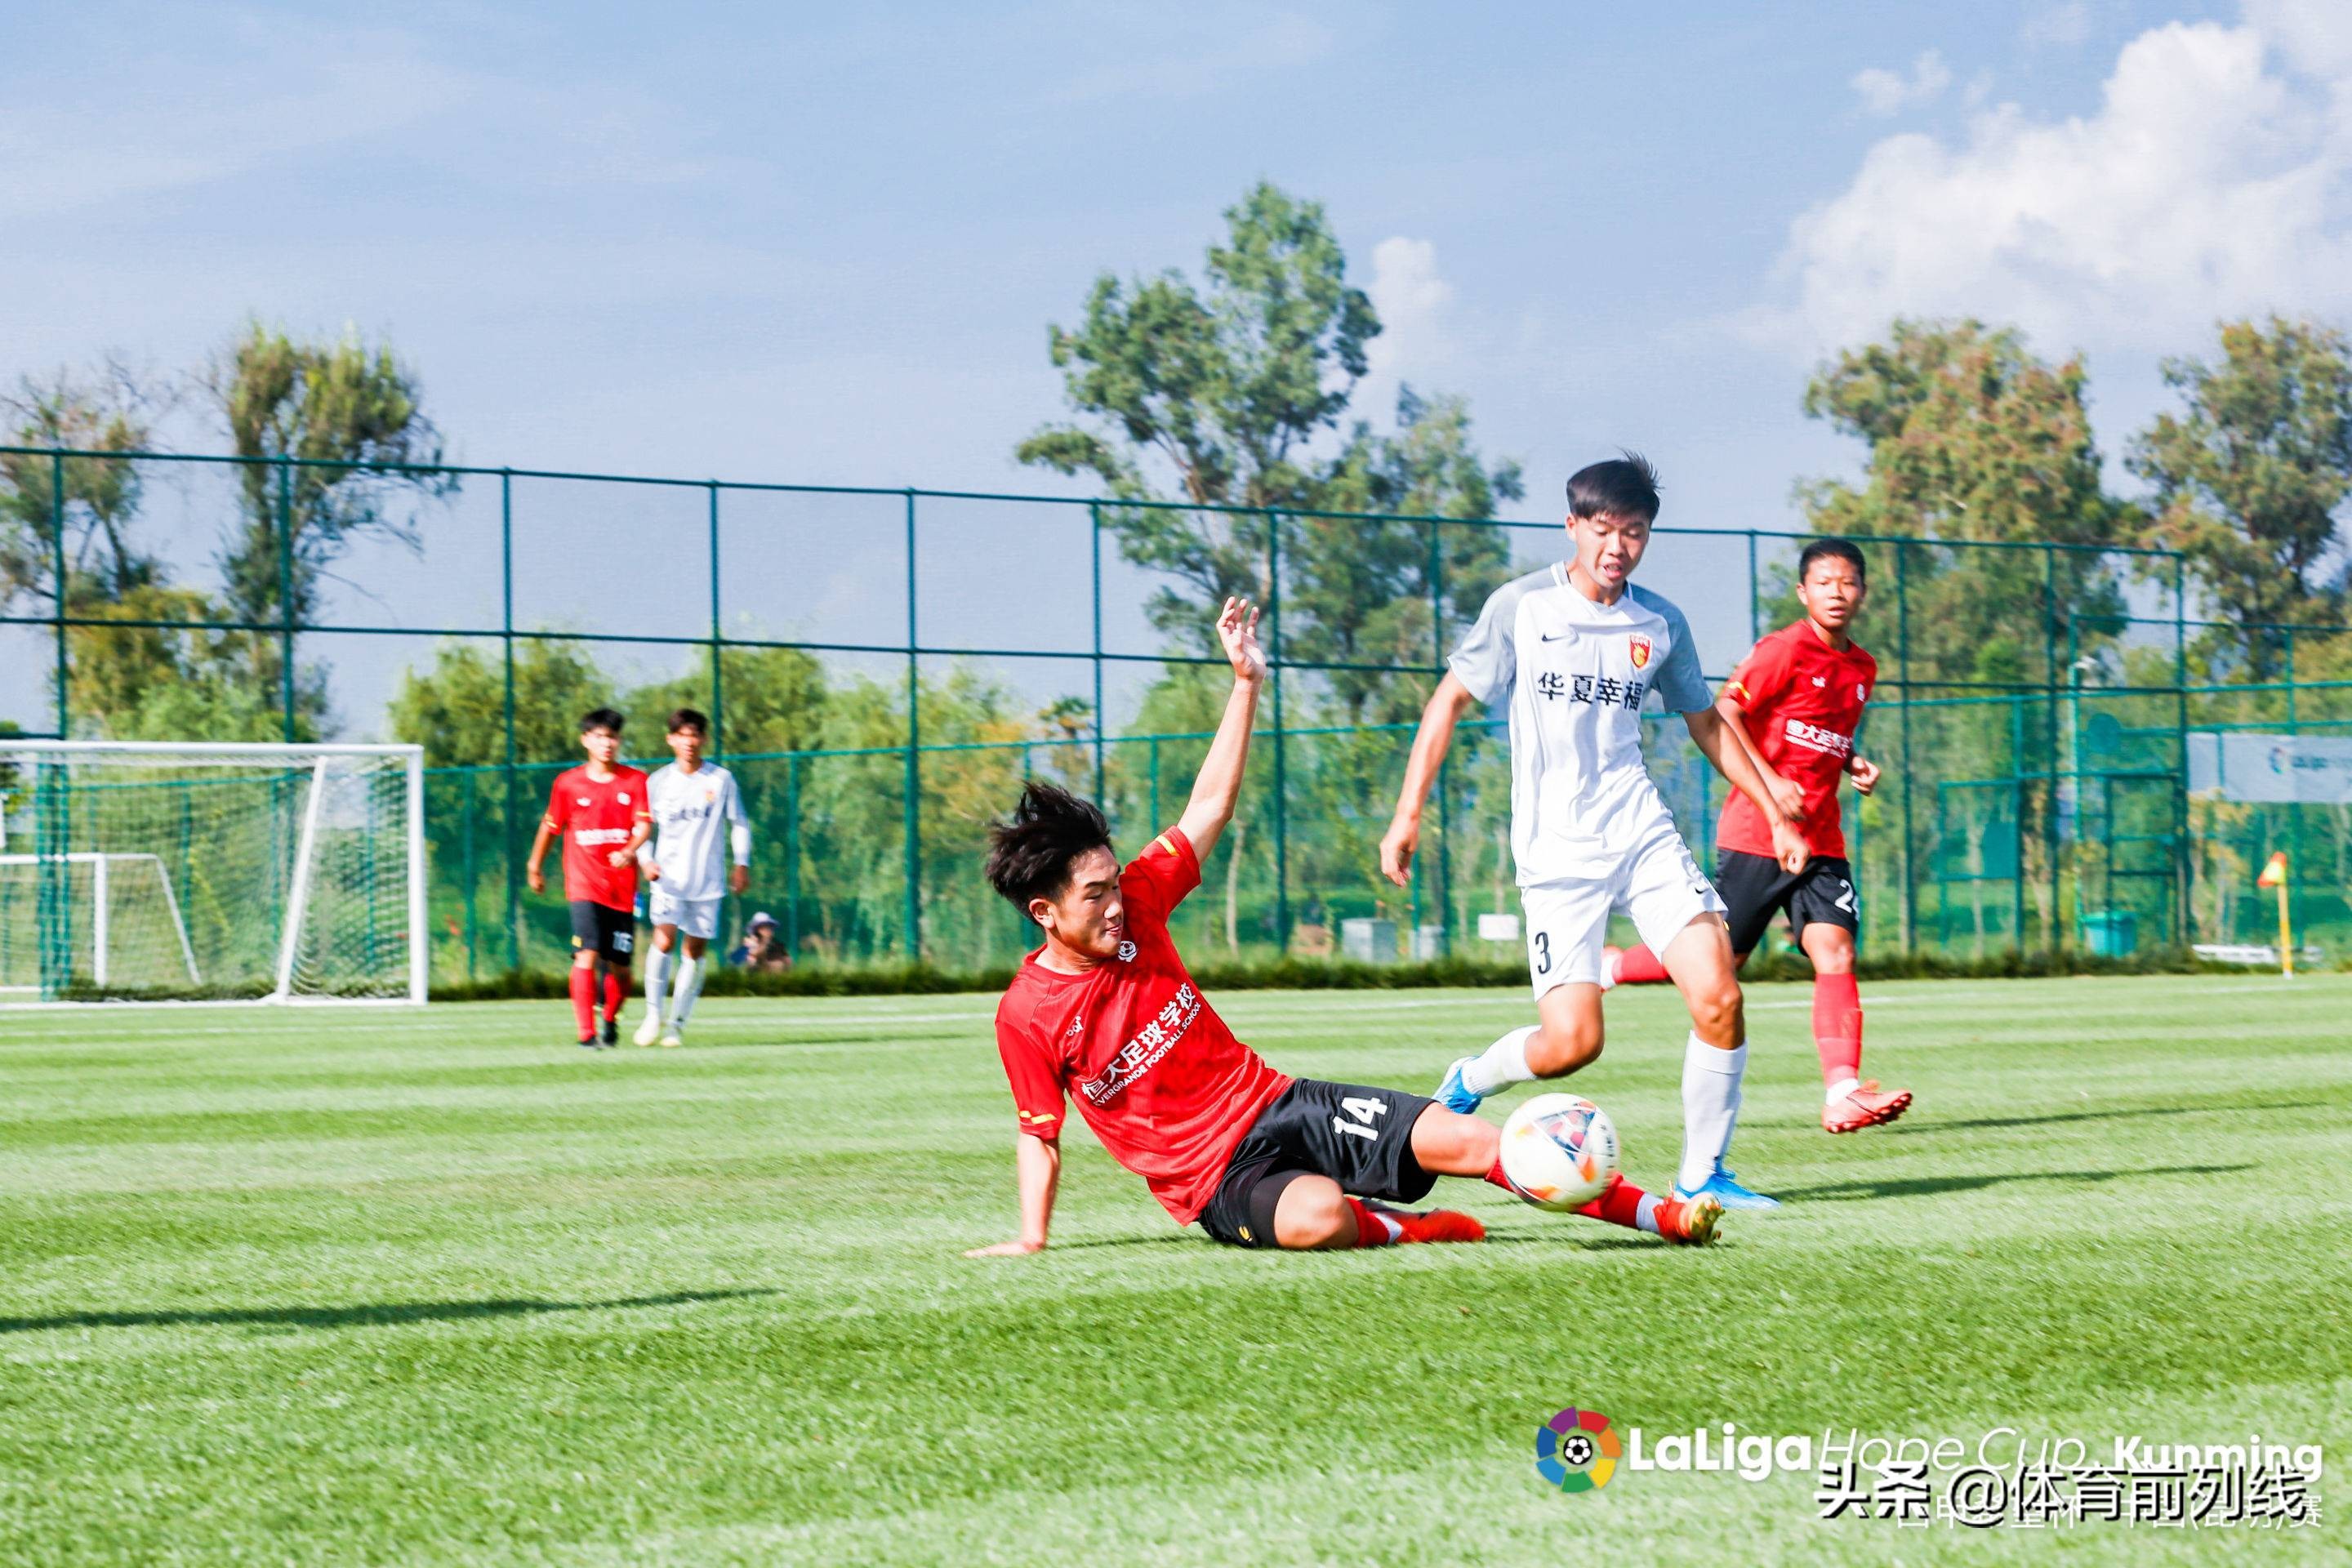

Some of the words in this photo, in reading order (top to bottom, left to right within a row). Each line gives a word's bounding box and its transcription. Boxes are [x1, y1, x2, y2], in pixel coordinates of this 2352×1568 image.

[1538, 671, 1644, 711] 华夏幸福
[1535, 932, 1552, 974] 3
[1081, 982, 1196, 1100] 恒大足球学校
[1145, 1029, 1184, 1068] FOOTBALL
[1181, 1002, 1201, 1031] SCHOOL
[1333, 1097, 1388, 1142] 14
